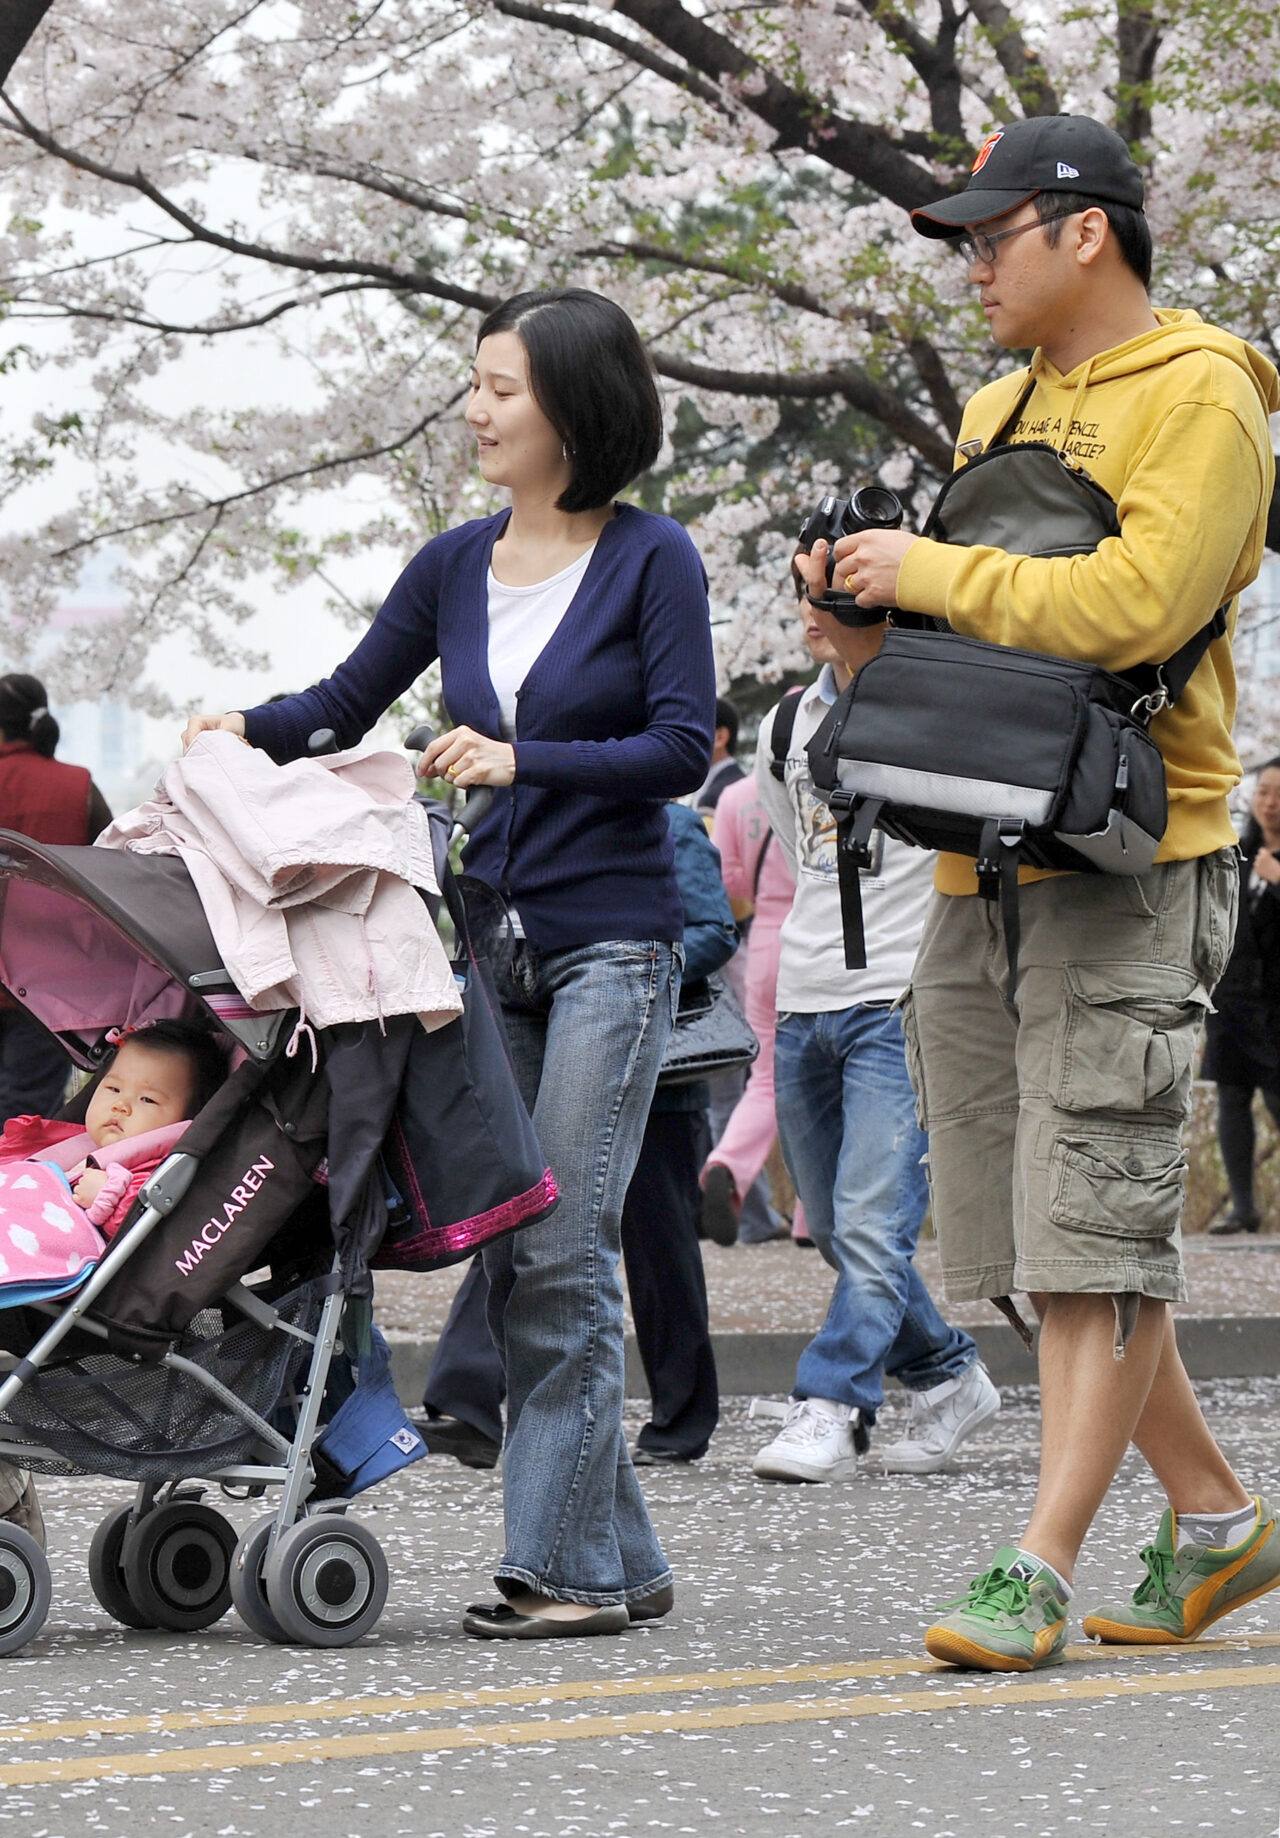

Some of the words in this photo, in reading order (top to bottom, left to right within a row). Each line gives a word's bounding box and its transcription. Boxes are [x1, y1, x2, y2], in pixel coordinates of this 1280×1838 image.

[1013, 420, 1030, 434] OU
[1051, 417, 1062, 433] A
[175, 1154, 275, 1276] MACLAREN
